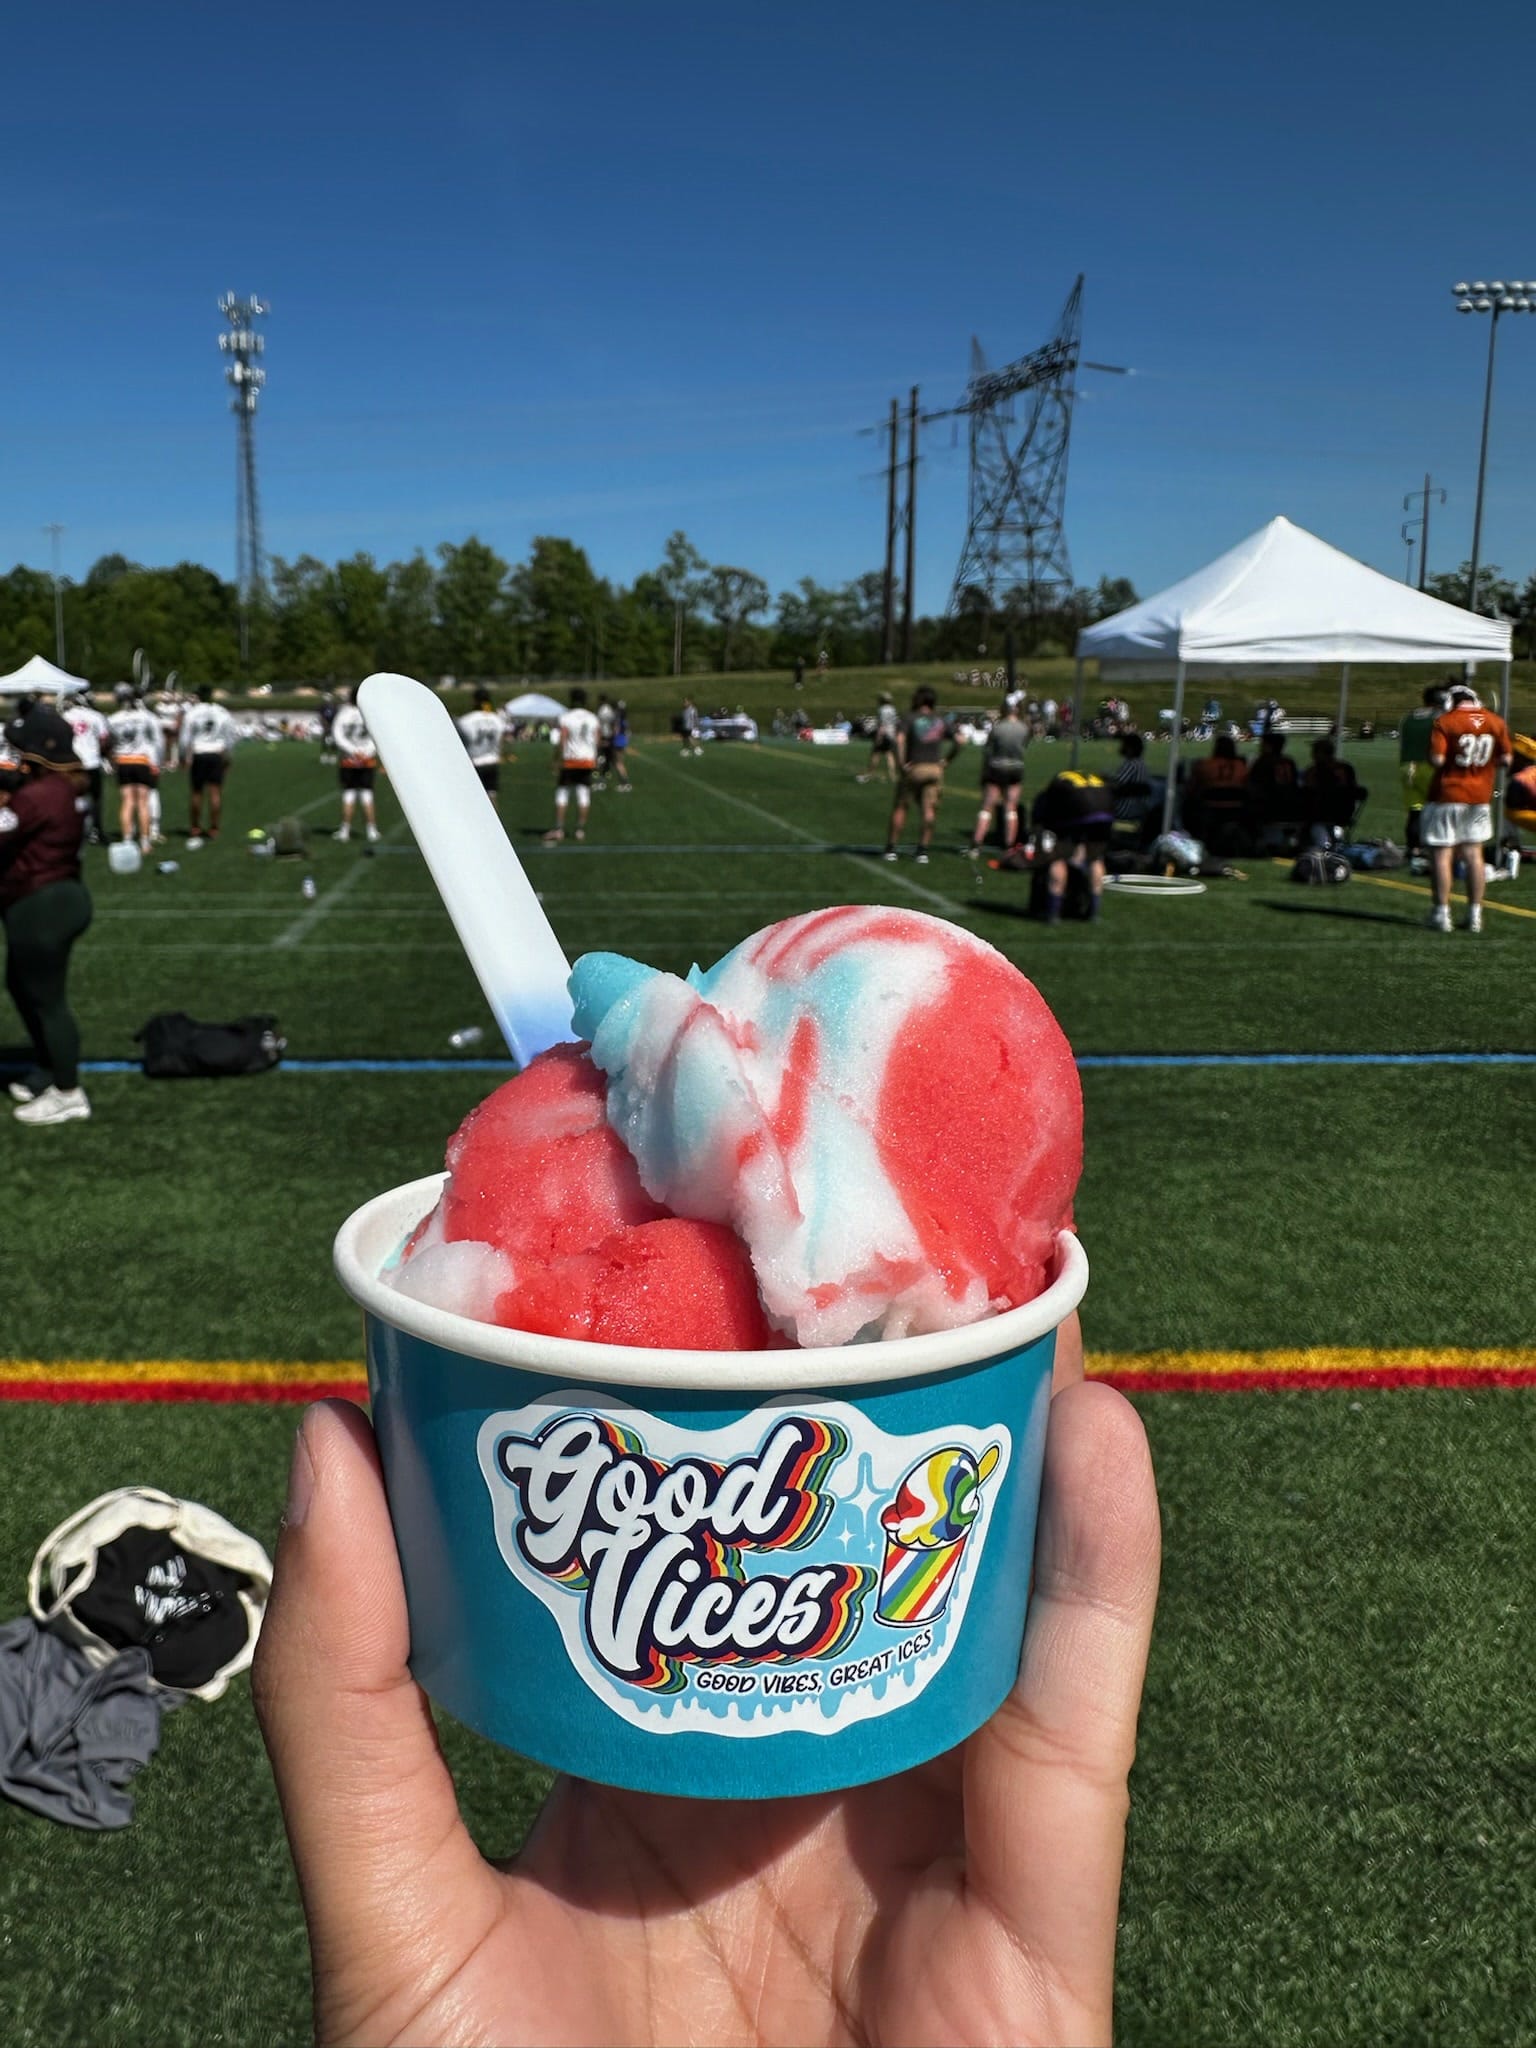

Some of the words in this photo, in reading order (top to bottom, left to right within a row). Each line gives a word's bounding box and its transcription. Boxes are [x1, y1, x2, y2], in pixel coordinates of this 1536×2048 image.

[1455, 733, 1494, 767] 30
[504, 1421, 803, 1565] Good
[581, 1519, 837, 1672] Vices
[697, 1671, 755, 1693] GOOD
[764, 1673, 822, 1693] VIBES,
[830, 1650, 893, 1687] GREAT
[899, 1630, 932, 1662] ICES
